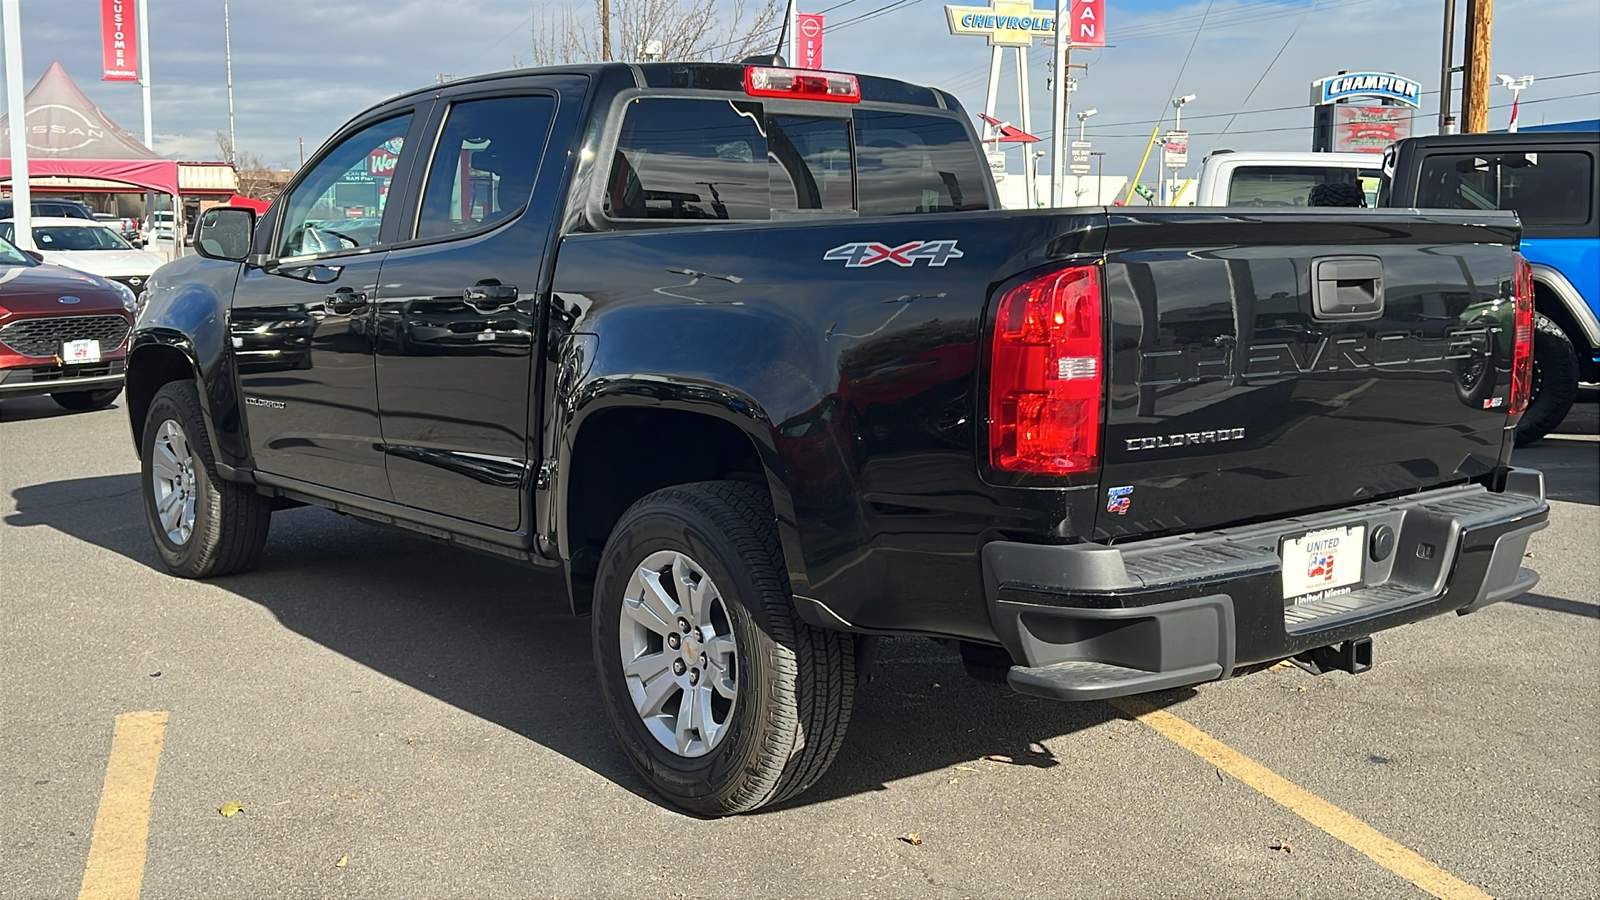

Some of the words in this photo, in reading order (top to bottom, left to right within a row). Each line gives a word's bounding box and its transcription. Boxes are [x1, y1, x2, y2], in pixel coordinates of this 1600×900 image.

[1080, 0, 1095, 37] AN
[105, 69, 136, 77] PARKING
[1328, 75, 1417, 97] CHAMPION
[1136, 327, 1502, 385] CHEVROLET
[245, 397, 286, 409] COLORADO
[1125, 427, 1245, 452] COLORADO
[1306, 537, 1340, 553] UNITED
[1294, 591, 1323, 606] United
[1324, 587, 1351, 599] Nissan
